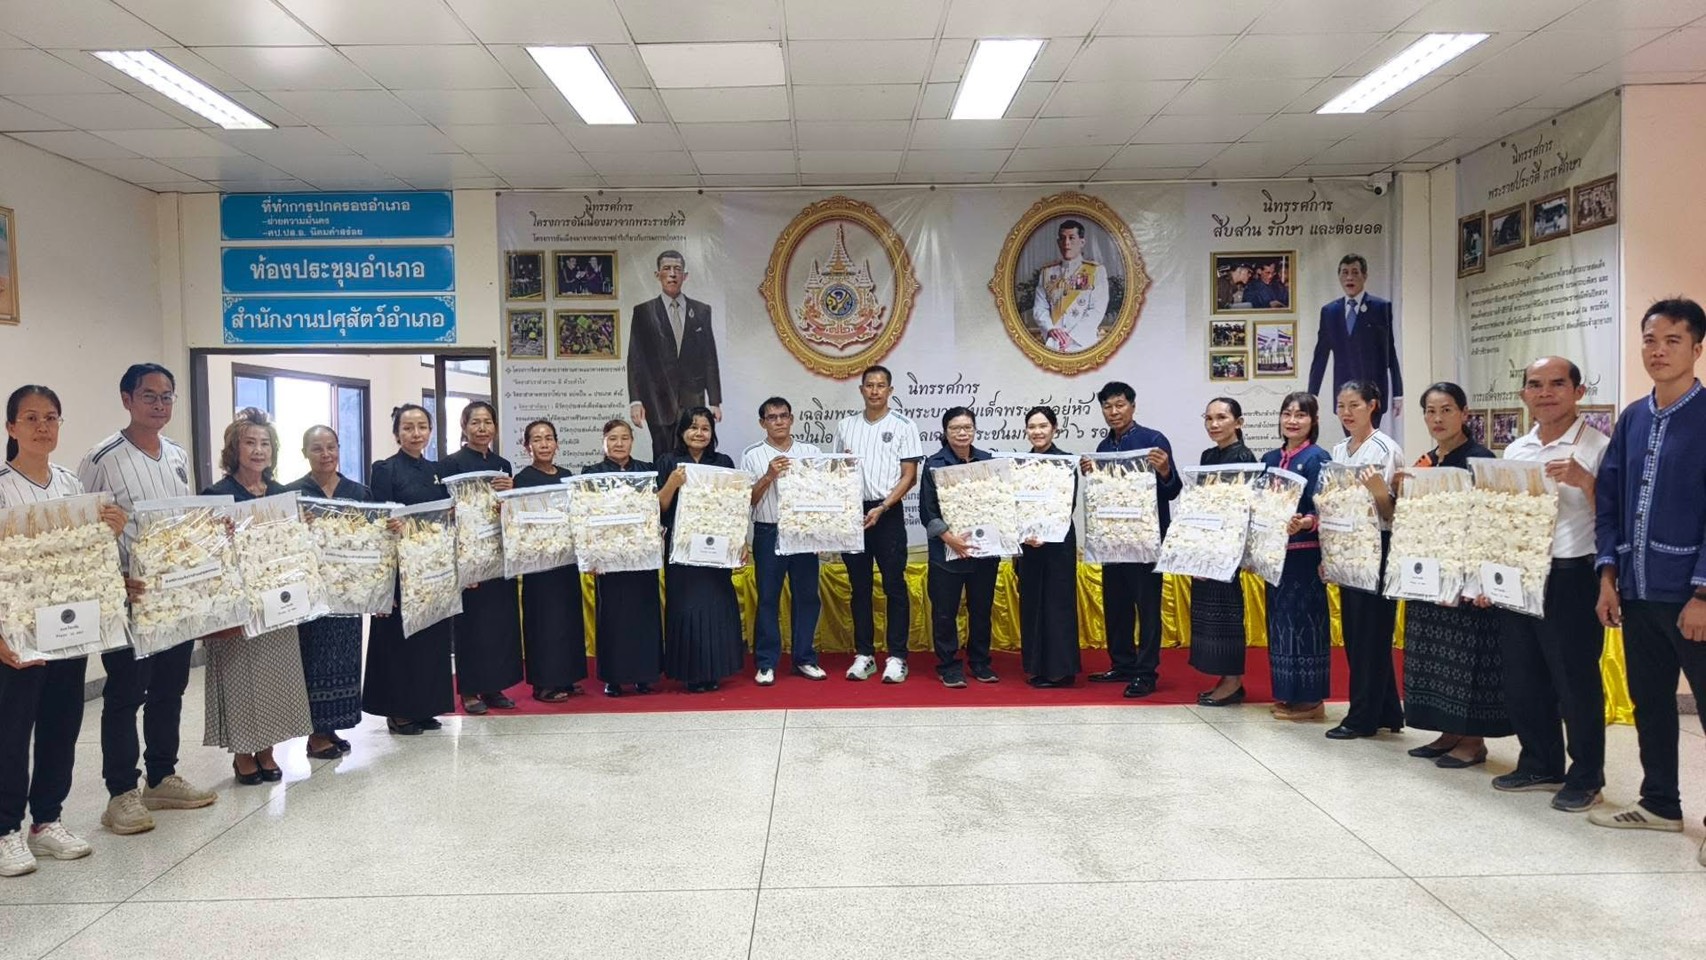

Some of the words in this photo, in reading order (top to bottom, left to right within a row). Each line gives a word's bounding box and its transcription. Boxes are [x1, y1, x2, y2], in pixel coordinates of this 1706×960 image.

[261, 196, 410, 213] ที่ทำการปกครองอำเภอ
[584, 195, 634, 212] นิทรรศการ
[1261, 189, 1333, 213] นิทรรศการ
[1212, 214, 1262, 238] สืบสาน
[1267, 214, 1304, 237] รักษา
[1310, 217, 1382, 236] และต่อยอด
[250, 254, 425, 288] ห้องประชุมอำเภอ
[231, 304, 445, 336] สำนักงานปศุสัตว์อำเภอ
[907, 371, 980, 395] นิทรรศการ
[1091, 427, 1109, 439] รอ
